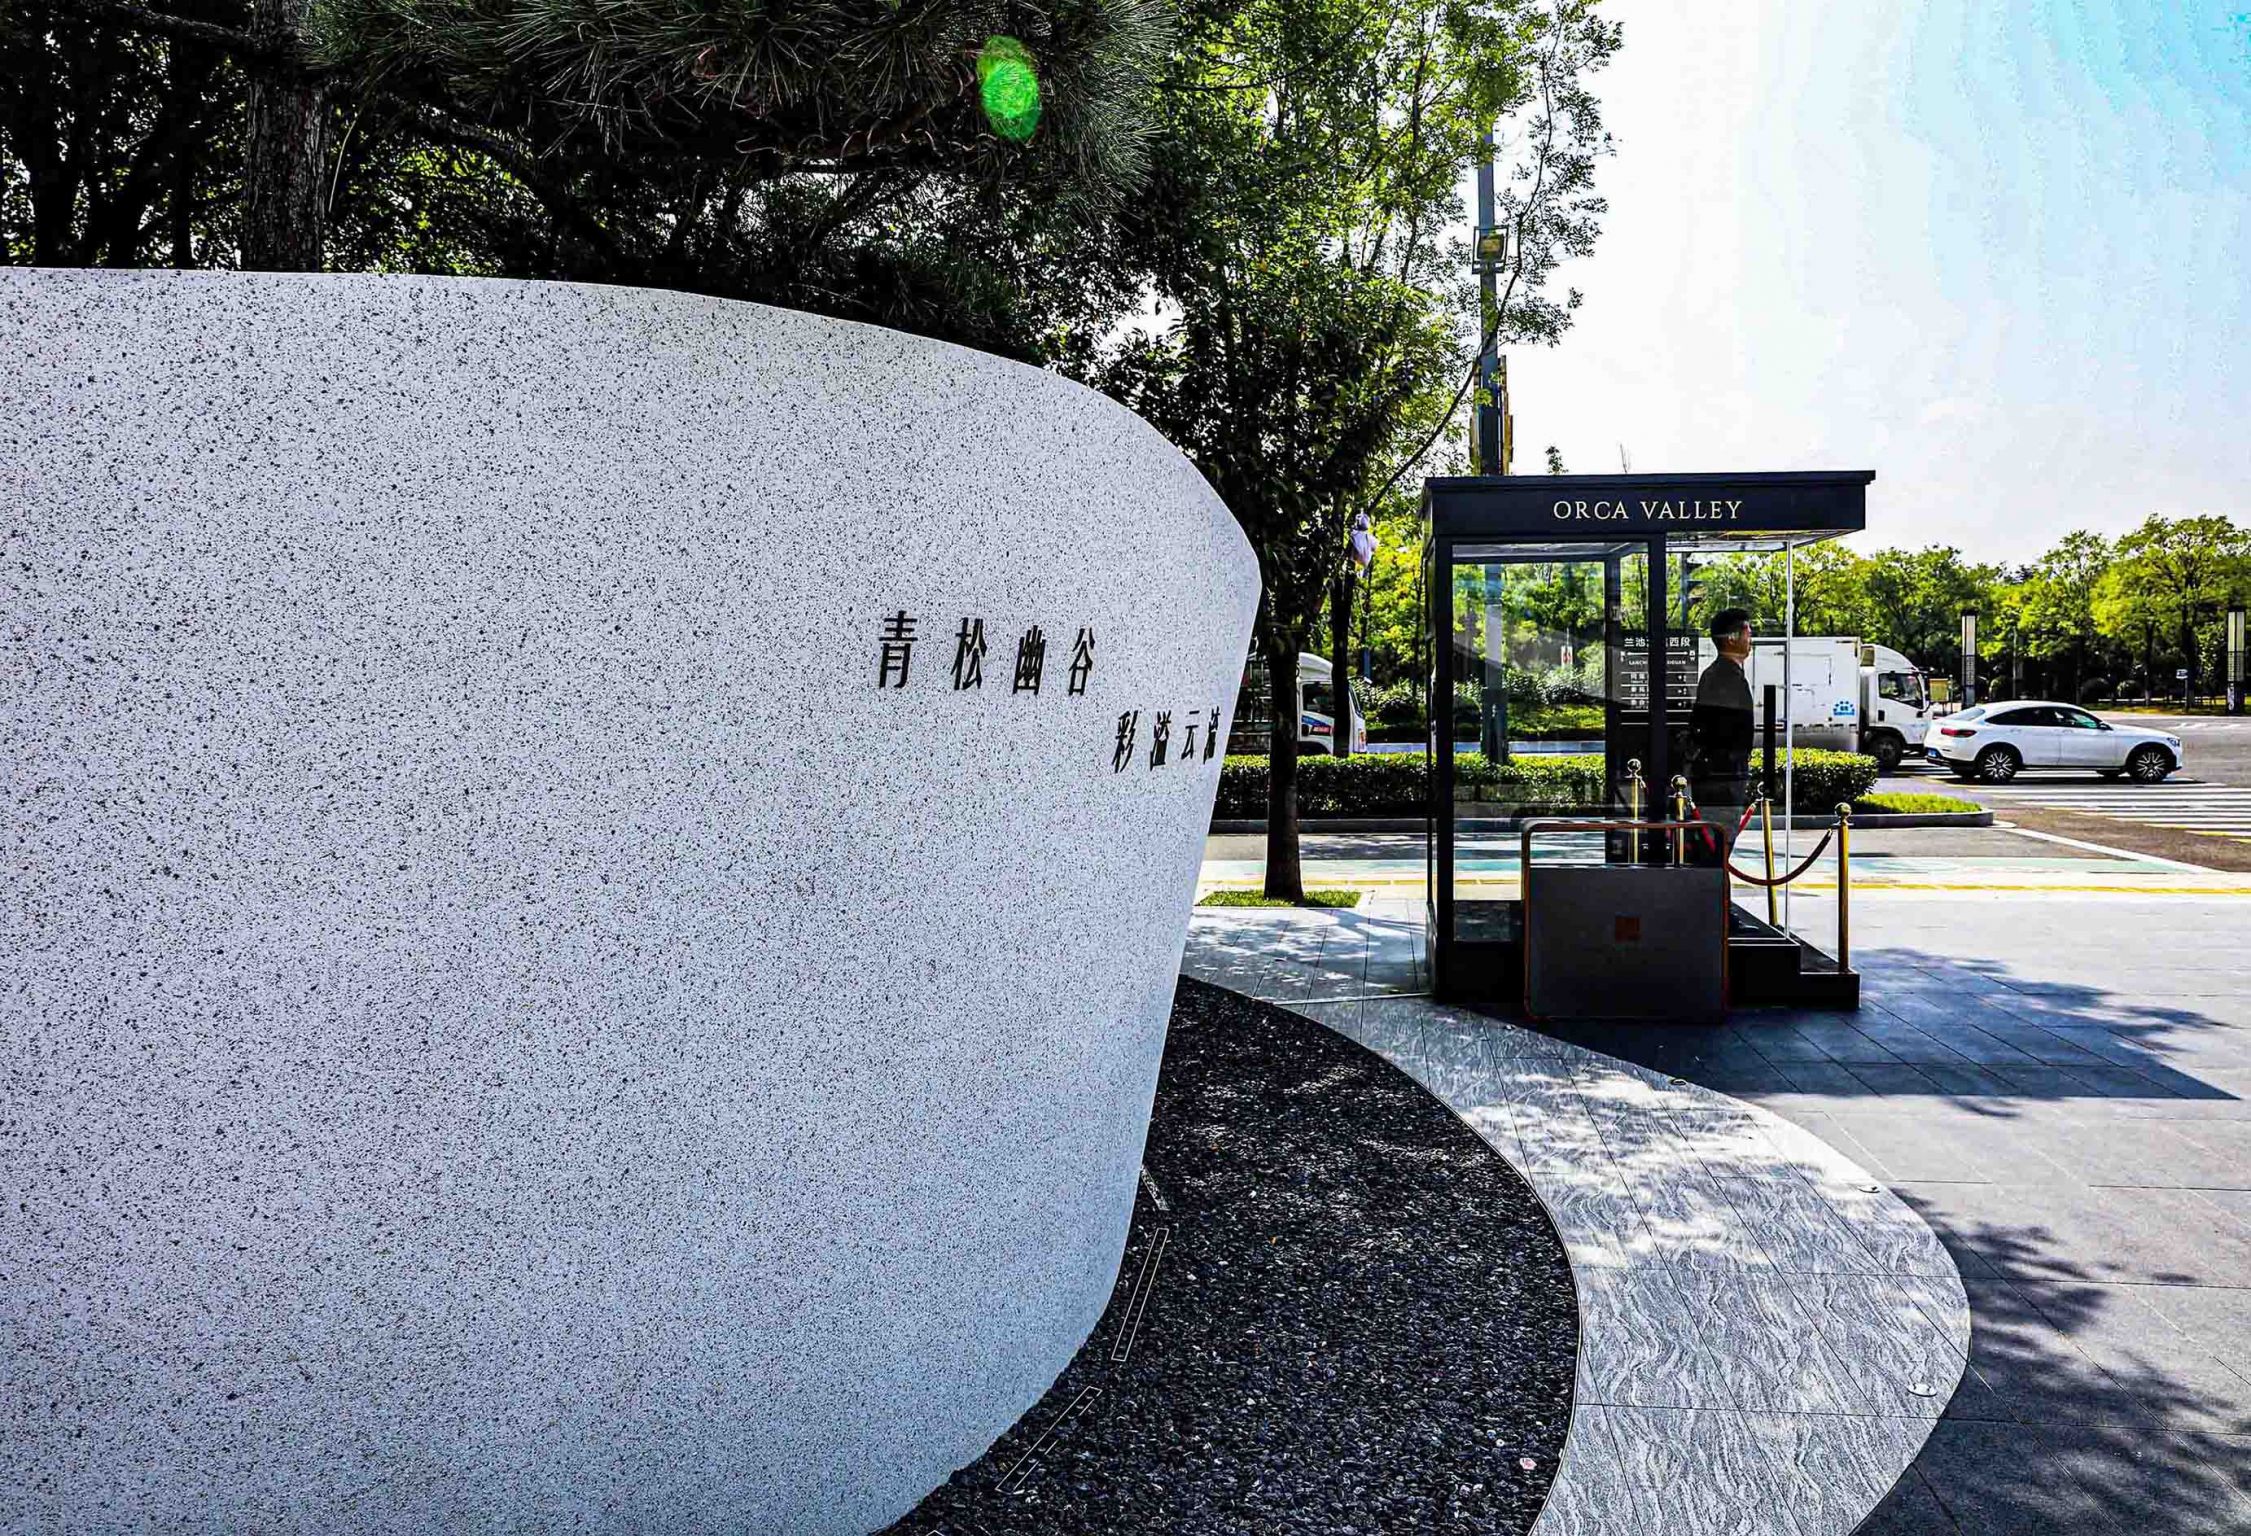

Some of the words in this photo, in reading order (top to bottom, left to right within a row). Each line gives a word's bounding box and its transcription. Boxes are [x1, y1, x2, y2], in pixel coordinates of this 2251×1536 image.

[1553, 500, 1630, 520] ORCA
[1639, 500, 1743, 520] VALLEY
[877, 610, 1096, 696] 青松幽谷
